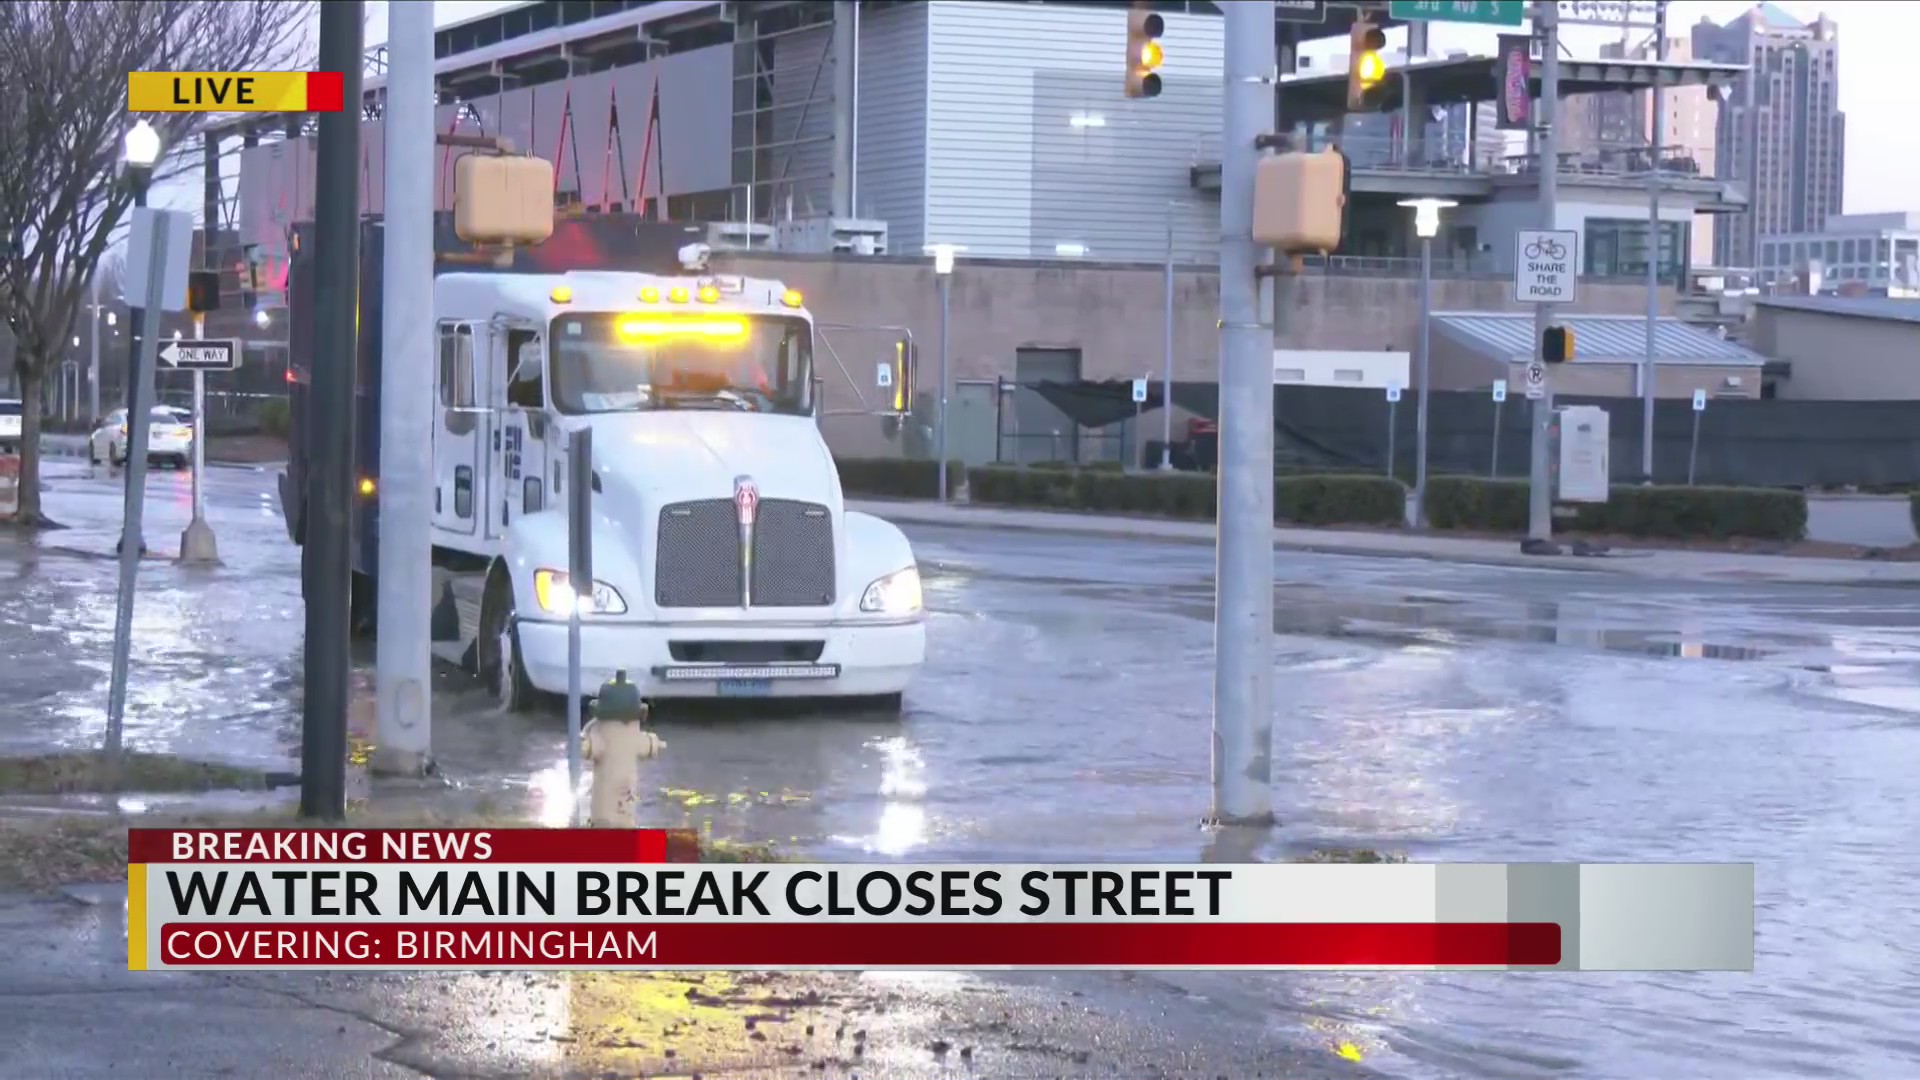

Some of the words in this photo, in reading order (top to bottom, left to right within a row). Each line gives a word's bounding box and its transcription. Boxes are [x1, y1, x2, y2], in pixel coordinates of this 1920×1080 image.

[1527, 262, 1566, 273] SHARE
[1537, 274, 1557, 284] THE
[1529, 285, 1562, 296] ROAD
[178, 349, 200, 360] ONE
[203, 349, 224, 360] WAY
